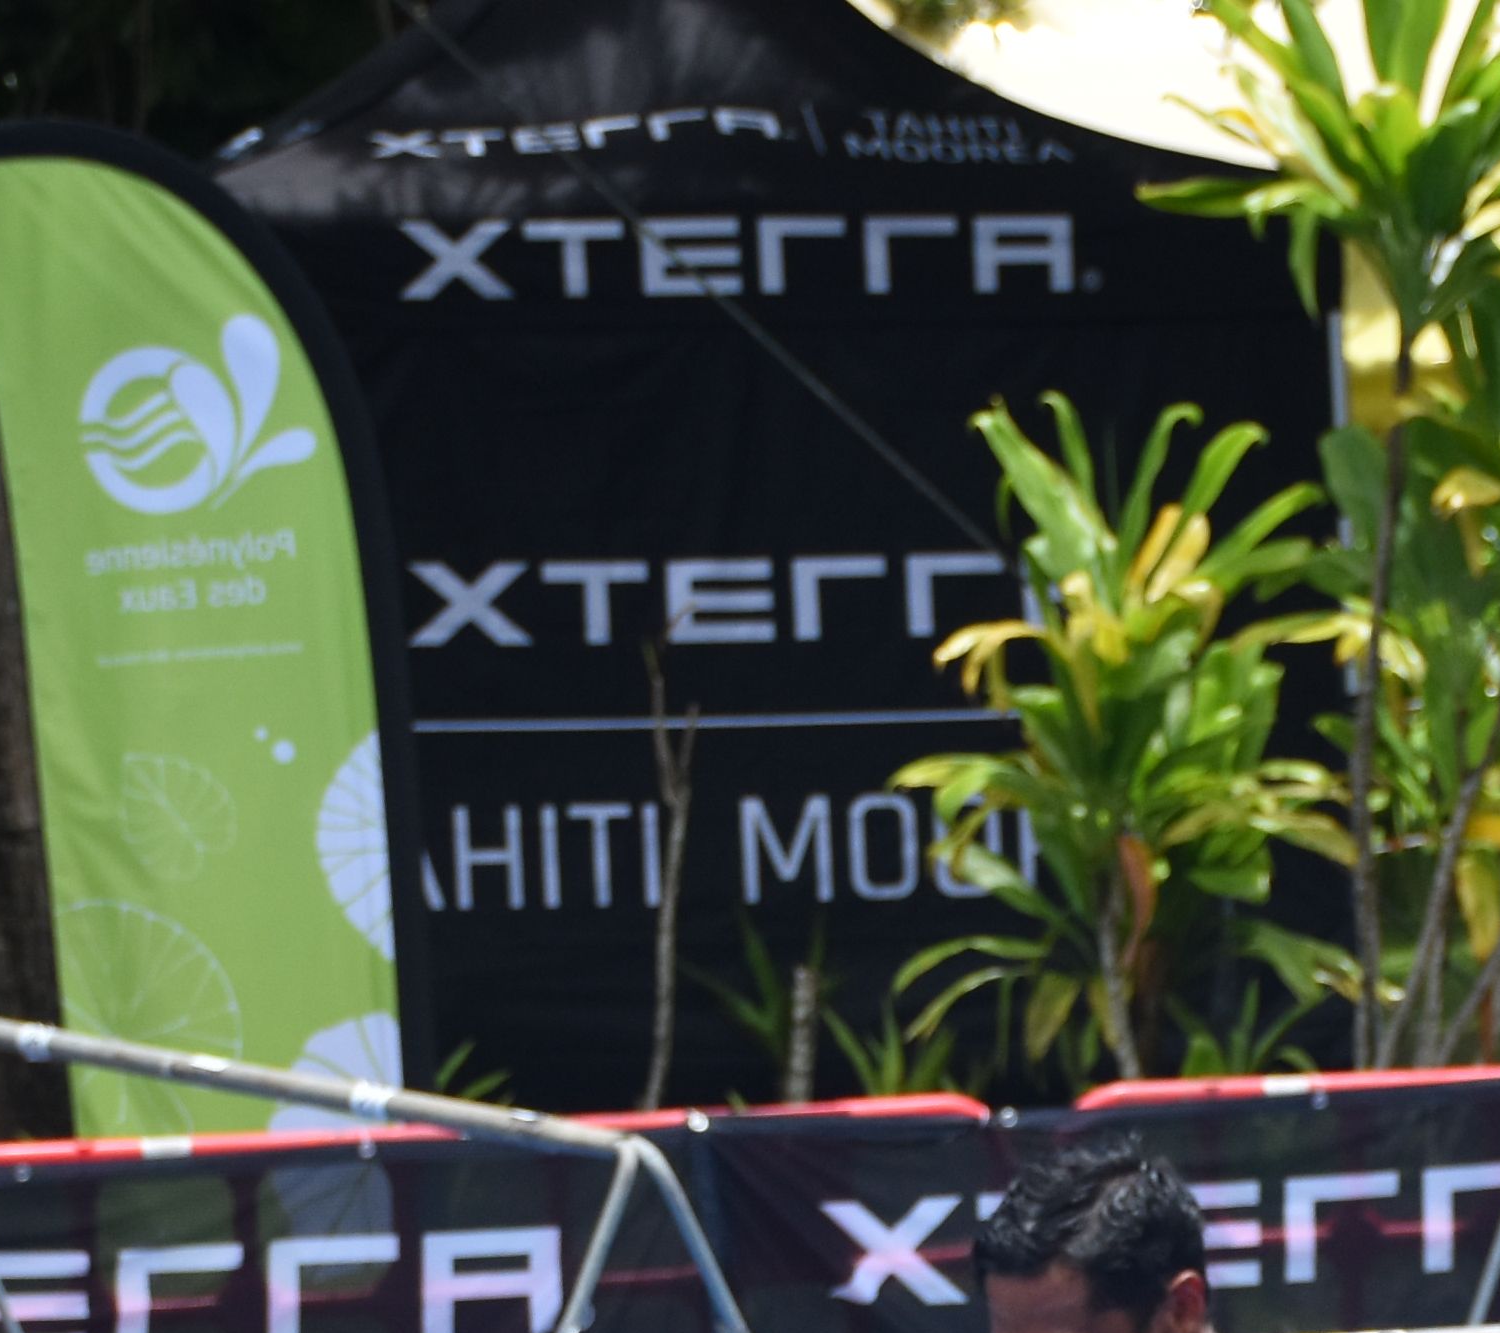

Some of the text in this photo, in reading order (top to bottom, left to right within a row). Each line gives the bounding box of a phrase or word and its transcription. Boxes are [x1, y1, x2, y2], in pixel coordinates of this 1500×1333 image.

[368, 106, 782, 158] XTERRA
[399, 213, 1077, 301] XTERRA
[408, 551, 1045, 648] XTERR
[420, 801, 666, 912] HITI
